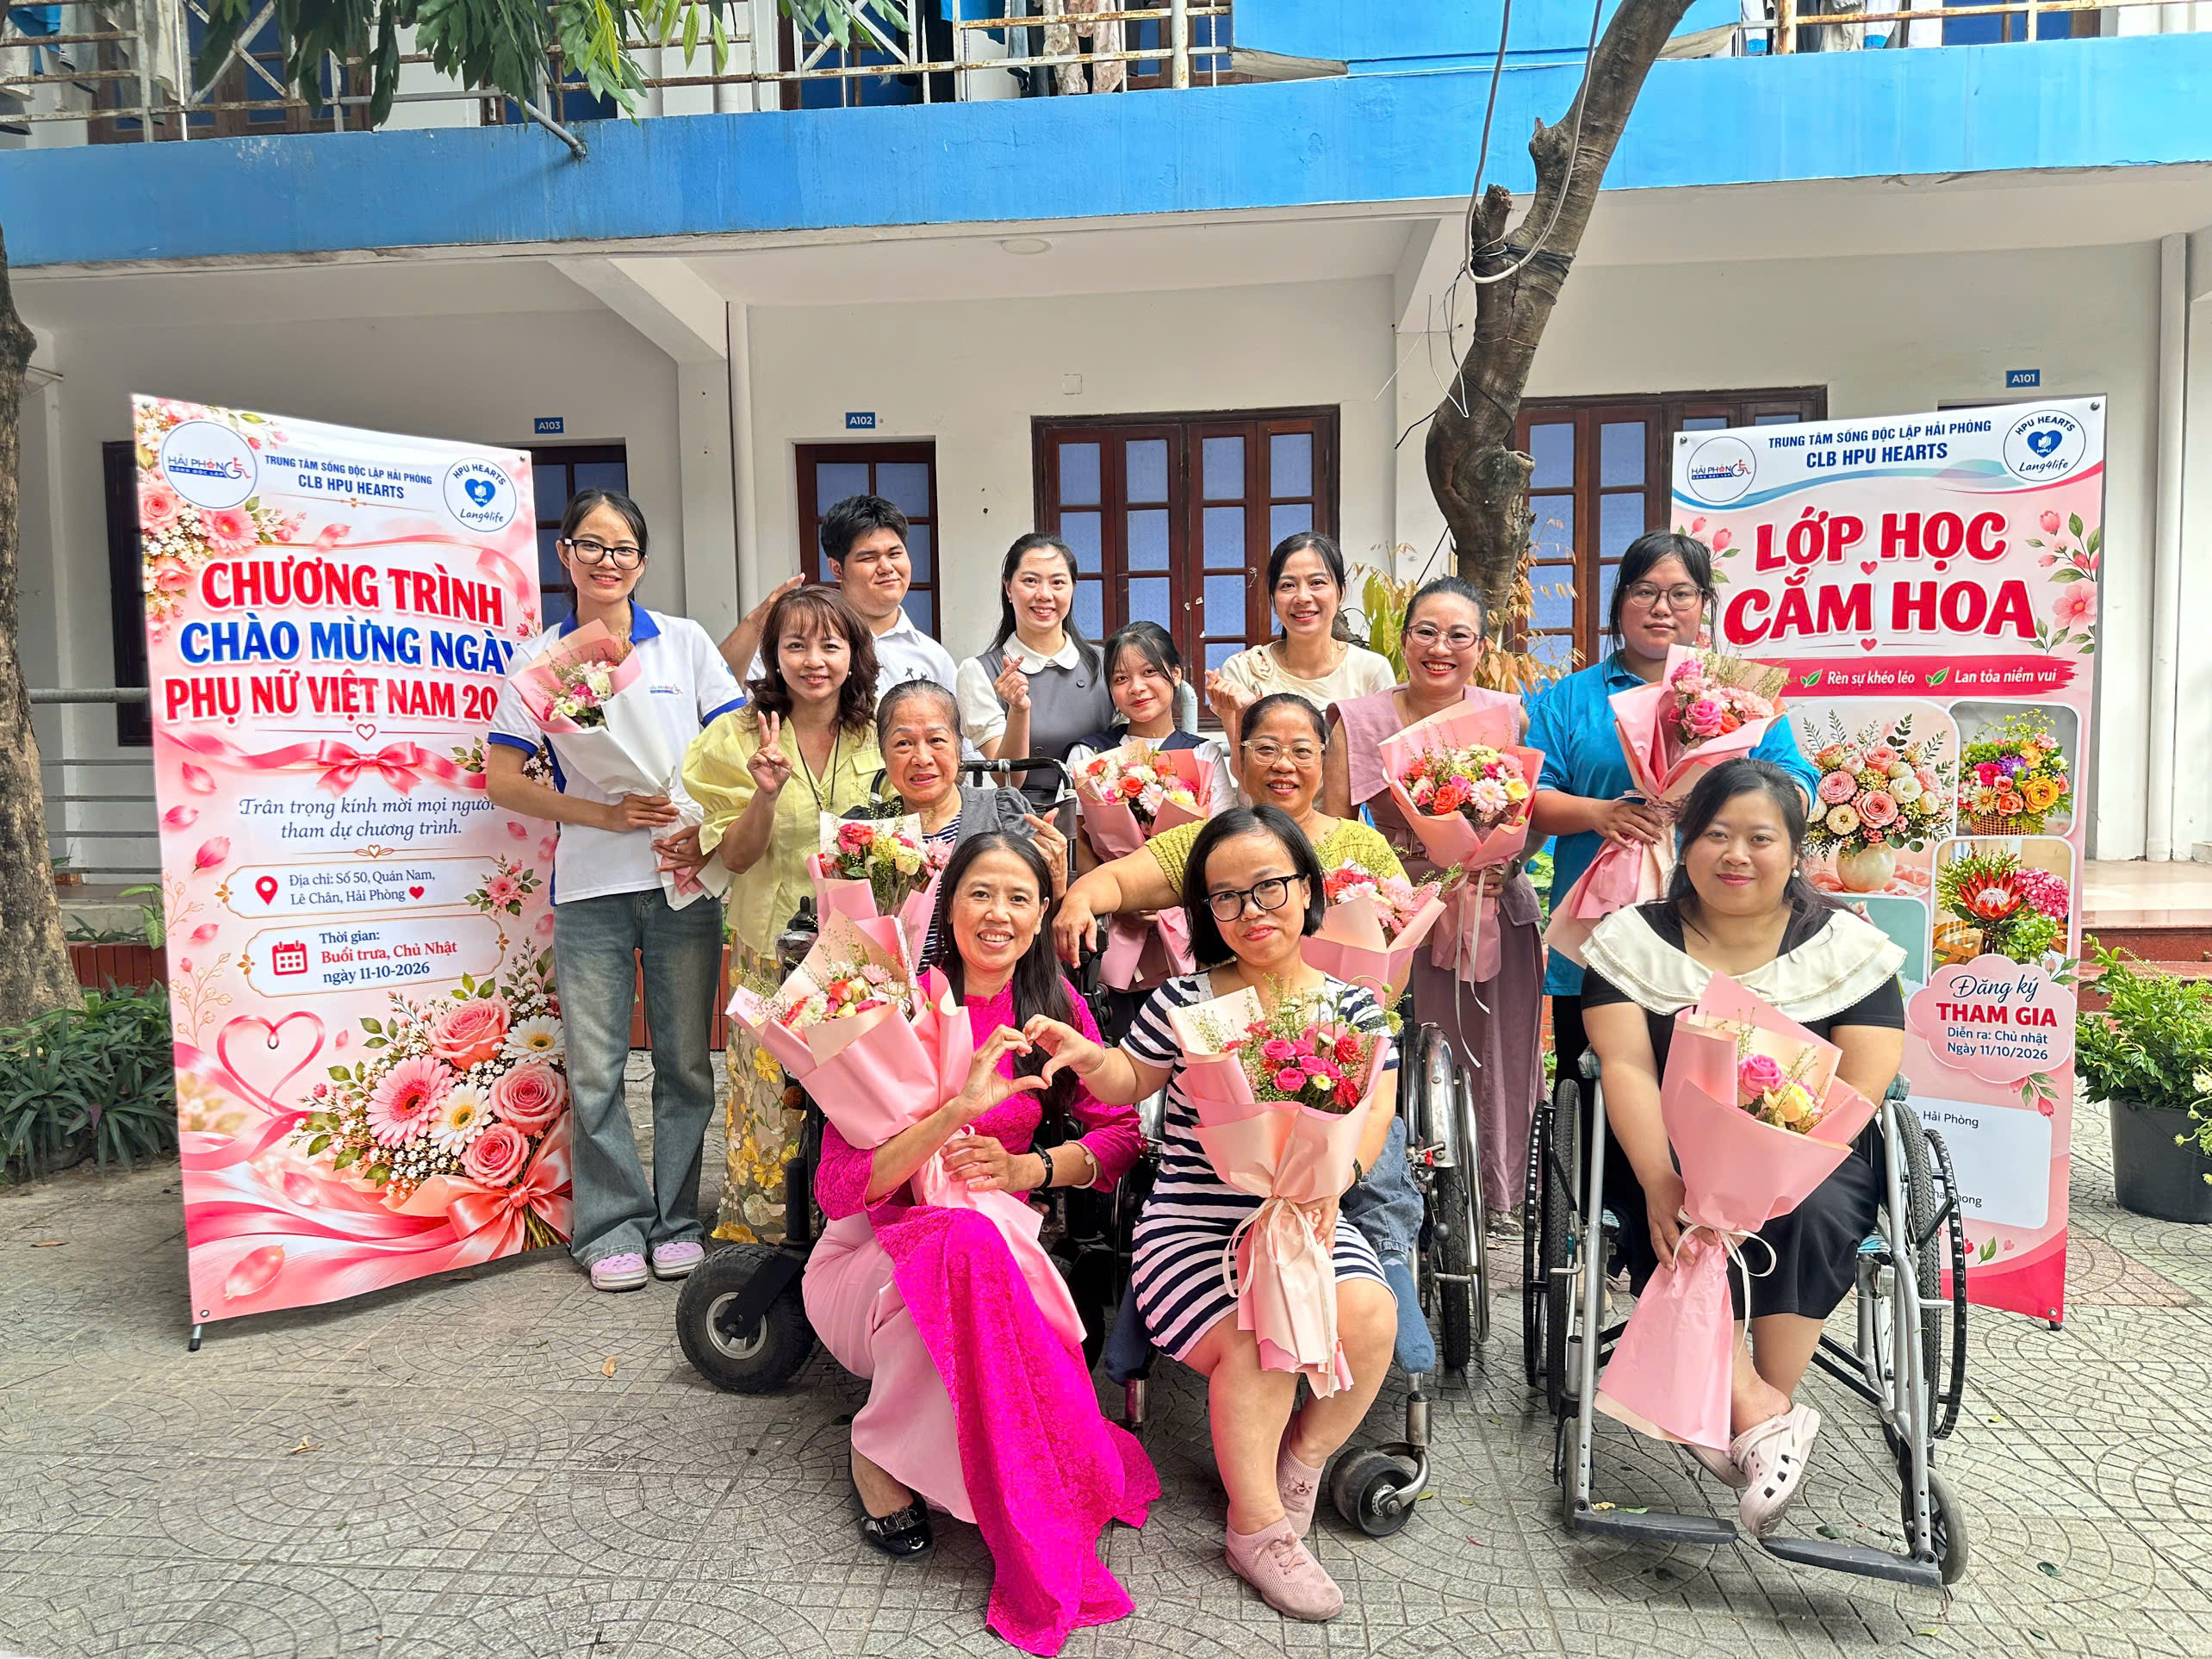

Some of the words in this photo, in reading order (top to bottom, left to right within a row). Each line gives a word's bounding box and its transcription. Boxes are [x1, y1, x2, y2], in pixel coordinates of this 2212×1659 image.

[2011, 374, 2035, 383] A101
[538, 421, 561, 430] A103
[849, 416, 873, 425] A102
[2015, 419, 2035, 435] HPU
[2037, 415, 2075, 432] HEARTS
[1768, 435, 1805, 448] TRUNG
[1809, 432, 1833, 445] TÂM
[1836, 427, 1868, 444] SỐNG
[1872, 427, 1895, 442] ĐỘC
[1898, 425, 1921, 440] LẬP
[1925, 421, 1945, 436] HẢI
[1949, 419, 1991, 434] PHÒNG
[1806, 450, 1836, 468] CLB
[1842, 447, 1876, 465] HPU
[1882, 442, 1948, 463] HEARTS
[2019, 459, 2068, 473] Lang4life
[264, 455, 295, 468] TRUNG
[299, 458, 318, 470] TÂM
[321, 460, 345, 474] SỐNG
[348, 464, 365, 477] ĐỘC
[368, 467, 384, 480] LẬP
[388, 468, 401, 482] HẢI
[404, 471, 432, 484] PHÒNG
[453, 464, 469, 479] HPU
[472, 463, 506, 485] HEARTS
[298, 475, 322, 489] CLB
[327, 478, 353, 492] HPU
[357, 482, 405, 499] HEARTS
[460, 508, 503, 522] Lang4life
[1755, 506, 1863, 571] LỚP
[1880, 512, 2006, 571] HỌC
[202, 555, 379, 608] CHƯƠNG
[388, 562, 503, 627] TRÌNH
[1724, 566, 1872, 645] CẮM
[1892, 580, 2037, 638] HOA
[180, 612, 299, 663] CHÀO
[310, 615, 420, 665] MỪNG
[1827, 670, 1849, 685] Rèn
[1852, 672, 1866, 687] sự
[1867, 670, 1894, 685] khéo
[1898, 669, 1915, 684] léo
[1954, 669, 1976, 683] Lan
[1980, 669, 2002, 683] tỏa
[2003, 667, 2034, 682] niềm
[2037, 668, 2057, 682] vui
[165, 676, 241, 724] PHỤ
[250, 668, 301, 714] NỮ
[306, 668, 379, 721] VIỆT
[386, 679, 456, 718] NAM
[239, 798, 284, 814] Trân
[290, 800, 335, 819] trọng
[341, 797, 377, 813] kính
[382, 798, 413, 812] mời
[418, 797, 447, 814] mọi
[282, 822, 325, 838] tham
[330, 821, 352, 840] dự
[356, 820, 413, 841] chương
[419, 818, 462, 835] trình.
[289, 873, 310, 887] Địa
[313, 873, 333, 885] chỉ:
[336, 871, 351, 884] Số
[353, 872, 370, 885] 50,
[372, 870, 403, 885] Quán
[406, 869, 435, 881] Nam,
[290, 893, 306, 905] Lê
[308, 892, 344, 904] Chân,
[346, 890, 366, 902] Hải
[369, 889, 406, 902] Phòng
[320, 931, 347, 944] Thời
[351, 930, 380, 944] gian:
[321, 947, 354, 964] Buổi
[357, 948, 390, 960] trưa,
[393, 943, 421, 957] Chủ
[425, 941, 457, 955] Nhật
[323, 968, 356, 985] ngày
[360, 961, 430, 979] 11-10-2026
[1949, 974, 2013, 1003] Đăng
[2016, 974, 2039, 1002] ký
[1936, 1003, 2008, 1024] THAM
[2016, 1007, 2058, 1028] GIA
[1948, 1026, 1973, 1039] Diễn
[1976, 1030, 1991, 1040] ra:
[1995, 1030, 2017, 1041] Chủ
[2021, 1033, 2047, 1046] nhật
[1948, 1042, 1977, 1056] Ngày
[1980, 1045, 2048, 1059] 11/10/2026
[1923, 1110, 1941, 1122] Hải
[1944, 1113, 1979, 1128] Phòng
